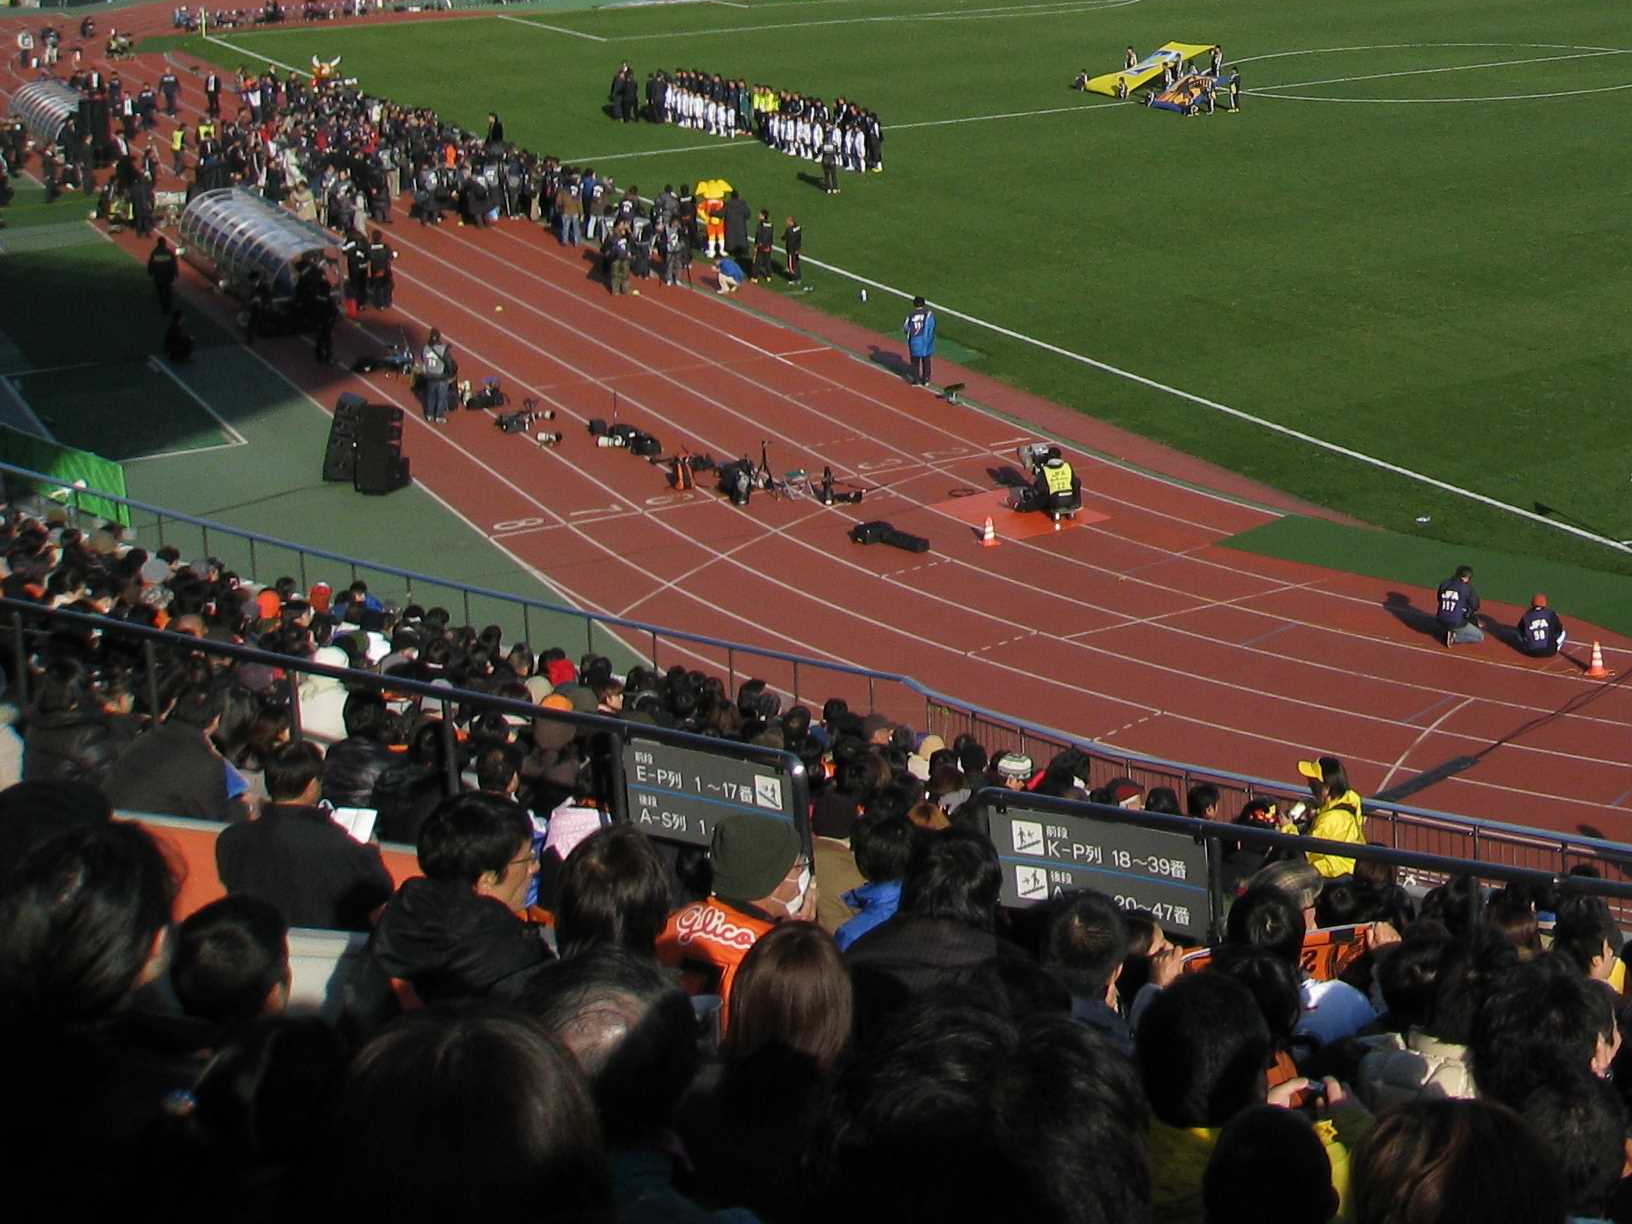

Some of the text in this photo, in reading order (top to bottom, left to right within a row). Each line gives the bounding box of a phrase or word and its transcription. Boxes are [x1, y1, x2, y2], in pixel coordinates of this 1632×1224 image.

[1441, 590, 1459, 601] JFA
[1529, 618, 1549, 630] JFA
[1046, 825, 1069, 839] 前段
[677, 905, 756, 949] Glico
